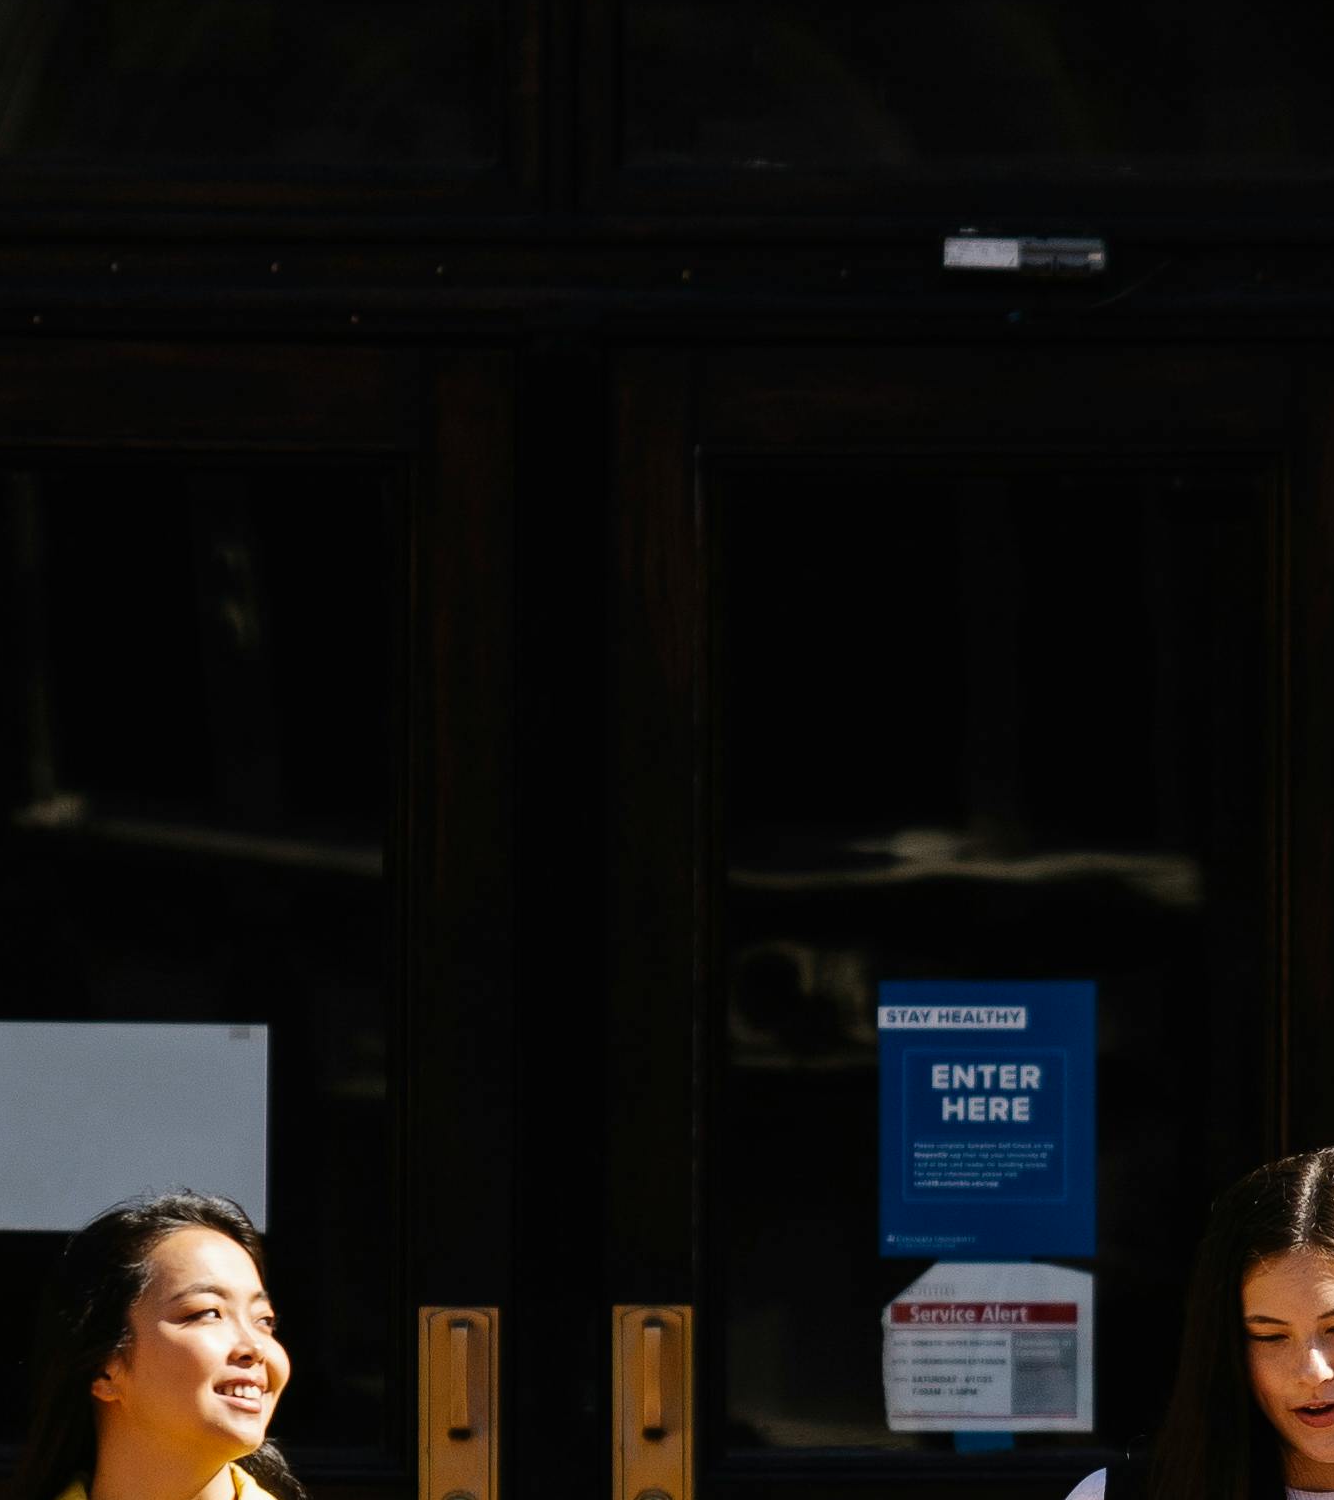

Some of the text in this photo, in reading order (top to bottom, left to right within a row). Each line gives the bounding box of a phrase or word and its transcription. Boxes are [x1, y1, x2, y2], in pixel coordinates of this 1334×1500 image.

[886, 1009, 1022, 1024] STAY HEALTHY
[931, 1063, 1042, 1089] ENTER
[941, 1097, 1030, 1121] HERE
[909, 1306, 1028, 1323] Service Alert
